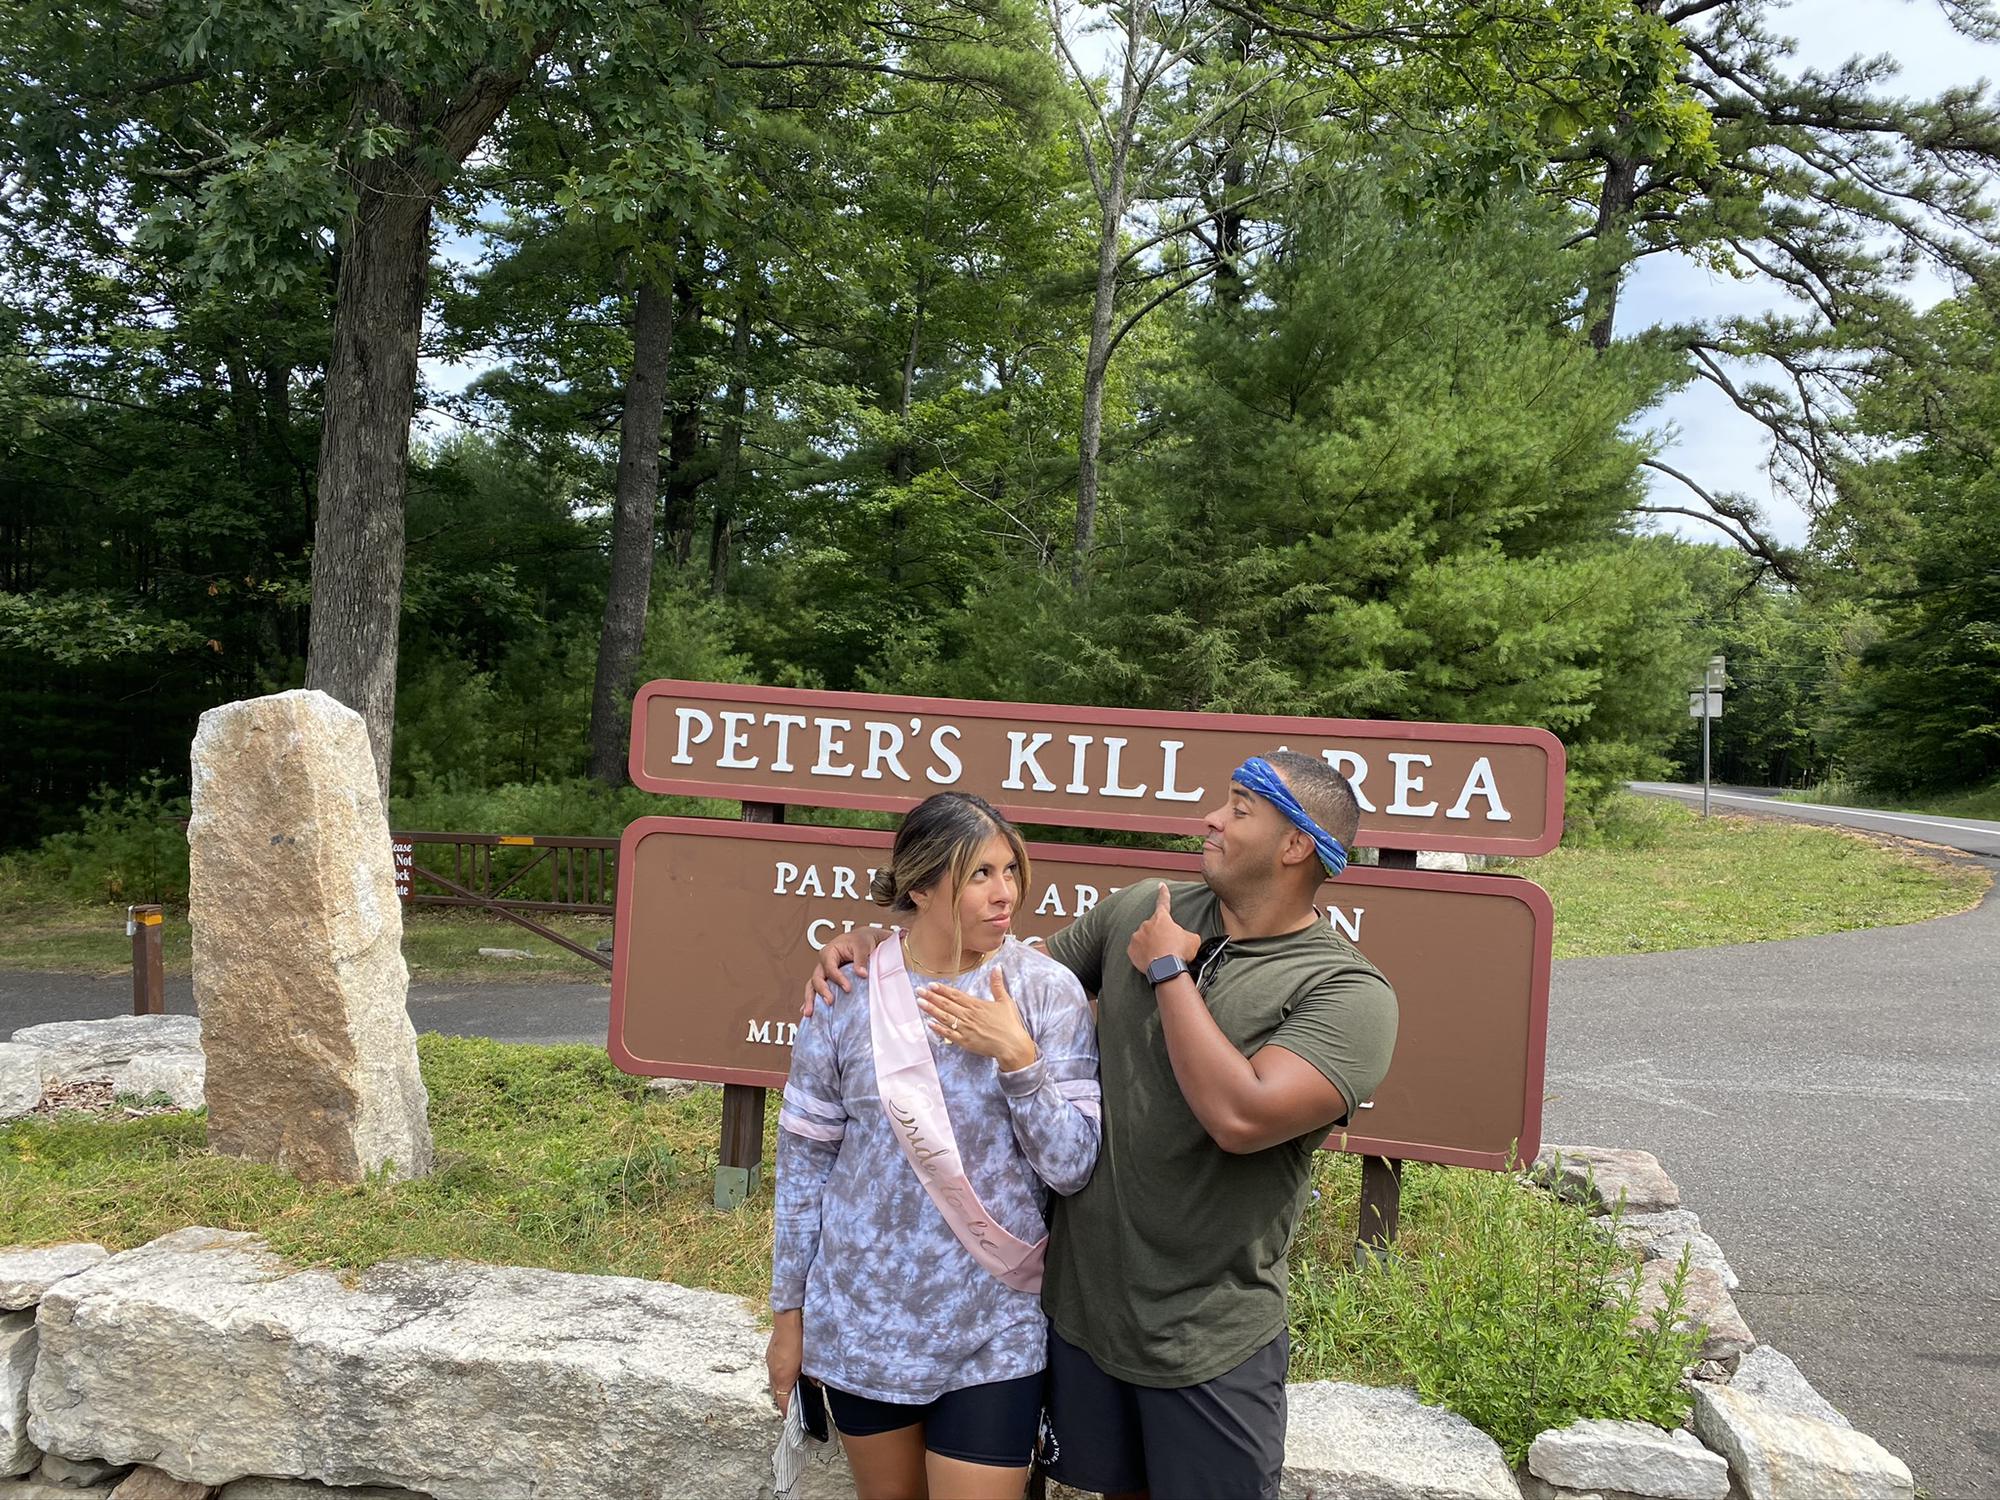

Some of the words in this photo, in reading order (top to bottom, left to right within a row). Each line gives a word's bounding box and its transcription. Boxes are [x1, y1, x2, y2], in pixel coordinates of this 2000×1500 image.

[671, 707, 963, 785] PETER'S
[1001, 731, 1206, 802] KILL
[1276, 745, 1512, 822] REA
[396, 853, 412, 866] Not
[395, 869, 410, 881] ock
[1034, 883, 1124, 918] AR
